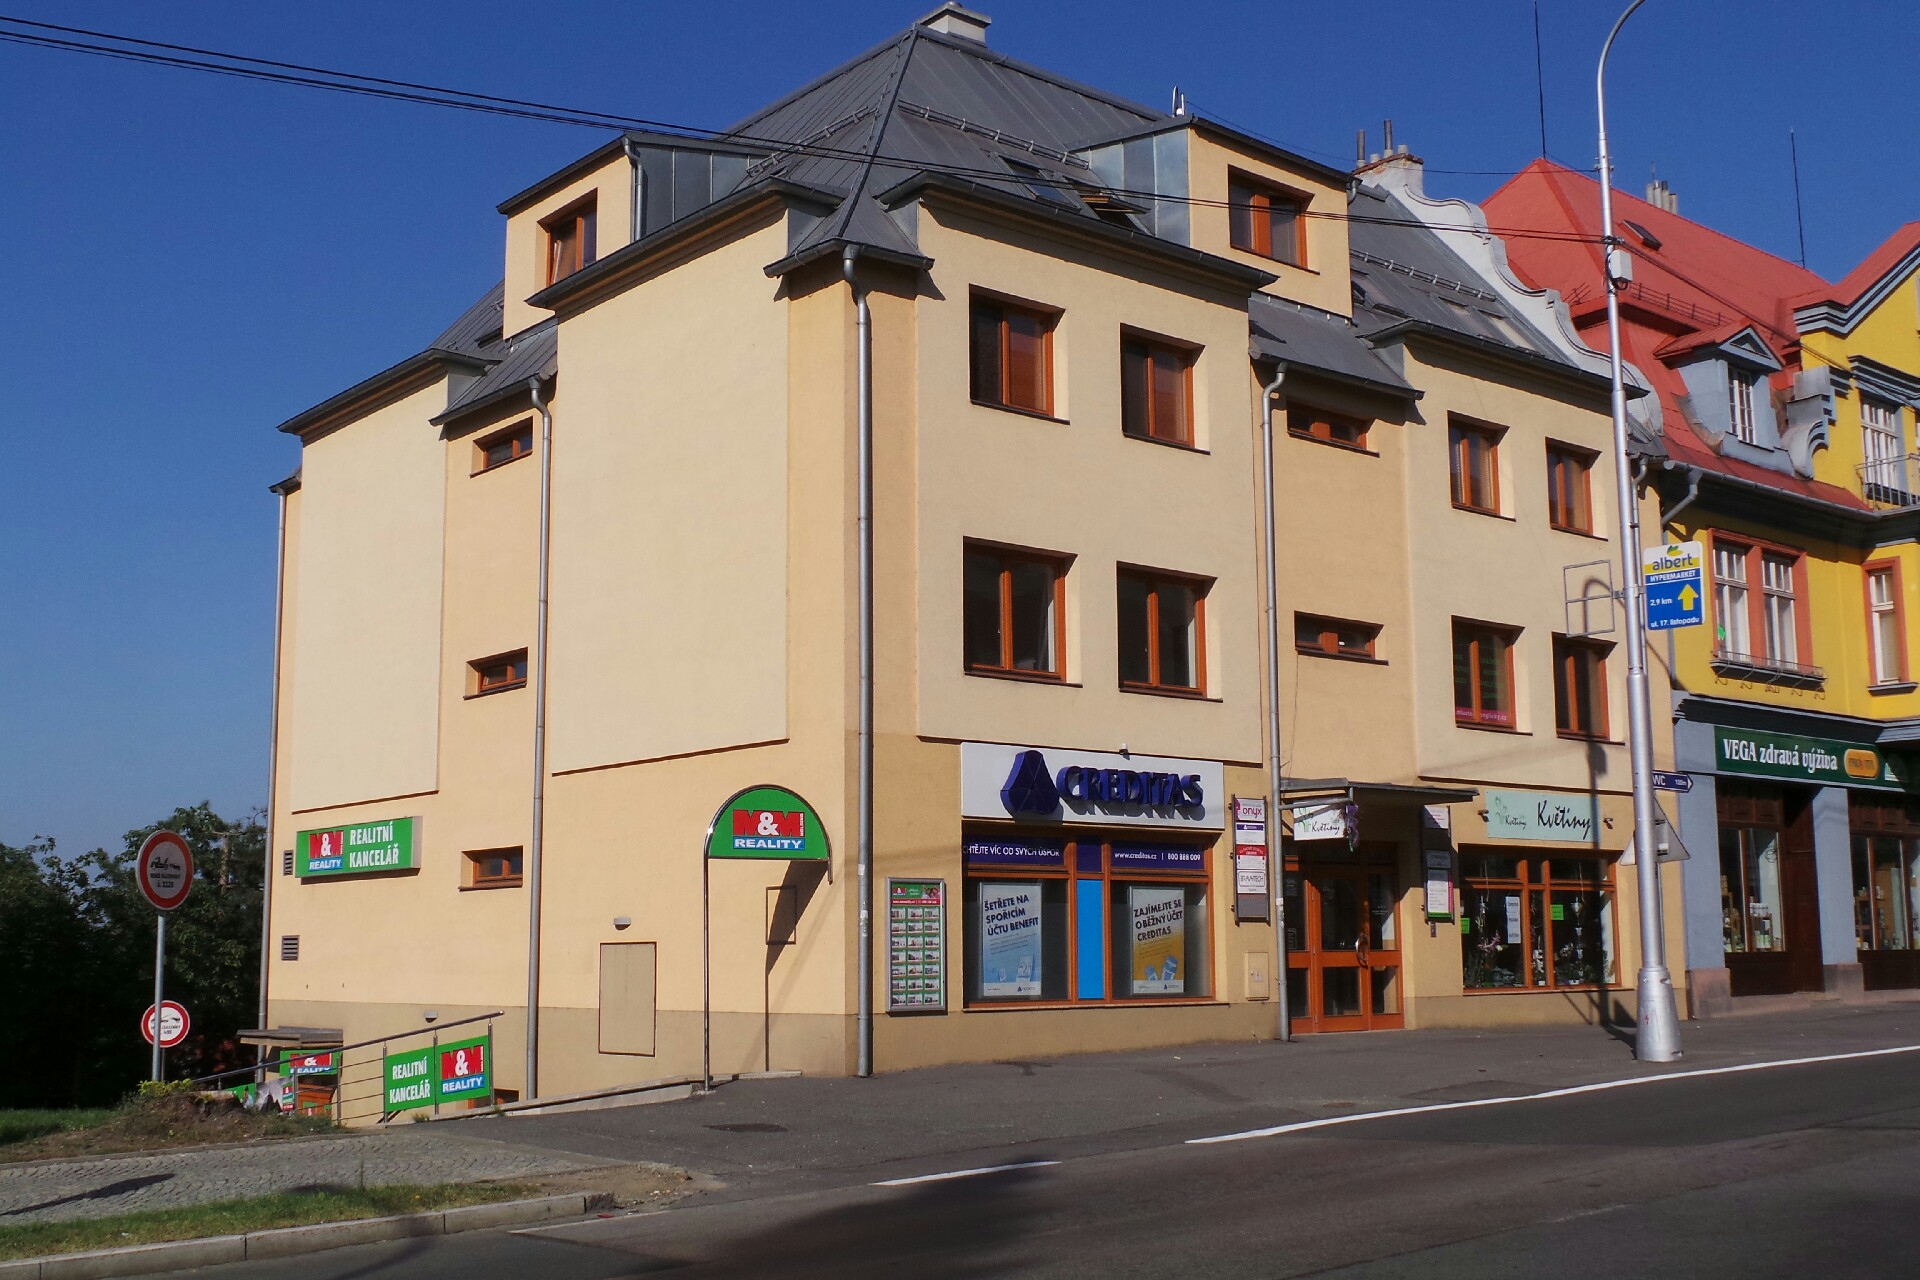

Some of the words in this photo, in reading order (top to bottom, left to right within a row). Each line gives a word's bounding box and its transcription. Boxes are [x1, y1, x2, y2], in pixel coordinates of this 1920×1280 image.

[1652, 553, 1693, 571] albert
[1650, 569, 1696, 583] HYPERMARKET
[1661, 597, 1672, 605] km
[1660, 619, 1669, 627] 17.
[1670, 616, 1700, 626] listopadu
[1722, 739, 1758, 762] VEGA
[1759, 744, 1799, 767] zdravá
[1801, 747, 1838, 774] výživa
[1056, 765, 1204, 807] CREDITAS
[1652, 774, 1666, 786] WC
[1242, 807, 1262, 819] onyx
[1537, 800, 1591, 841] Květiny
[732, 809, 800, 837] M&M
[349, 821, 394, 846] REALITNÍ
[308, 830, 341, 859] M&M
[733, 838, 802, 849] REALITY
[962, 843, 989, 855] CHTĚJTE
[989, 844, 1002, 855] VÍC
[1002, 846, 1014, 856] OD
[1038, 846, 1060, 857] ÚSPOR
[308, 859, 342, 870] REALITY
[349, 843, 399, 868] KANCELÁŘ
[1114, 851, 1157, 860] www.creditas.cz
[1167, 852, 1179, 861] 800
[1179, 852, 1190, 861] 888
[1190, 853, 1201, 861] 009
[984, 897, 1015, 912] ŠETŘETE
[1016, 894, 1030, 905] NA
[1133, 901, 1172, 918] ZAJÍMEJTE
[1173, 899, 1182, 908] SE
[986, 906, 1026, 924] SPOŘICÍM
[1142, 912, 1167, 929] BĚŽNÝ
[1167, 909, 1183, 922] ÚČET
[987, 923, 1009, 936] ÚČTU
[1009, 916, 1039, 931] BENEFIT
[1137, 926, 1172, 941] CREDITAS
[392, 1055, 428, 1080] REALITNÍ
[441, 1045, 481, 1080] M&M
[389, 1079, 431, 1104] KANCELÁŘ
[442, 1076, 483, 1093] REALITY
